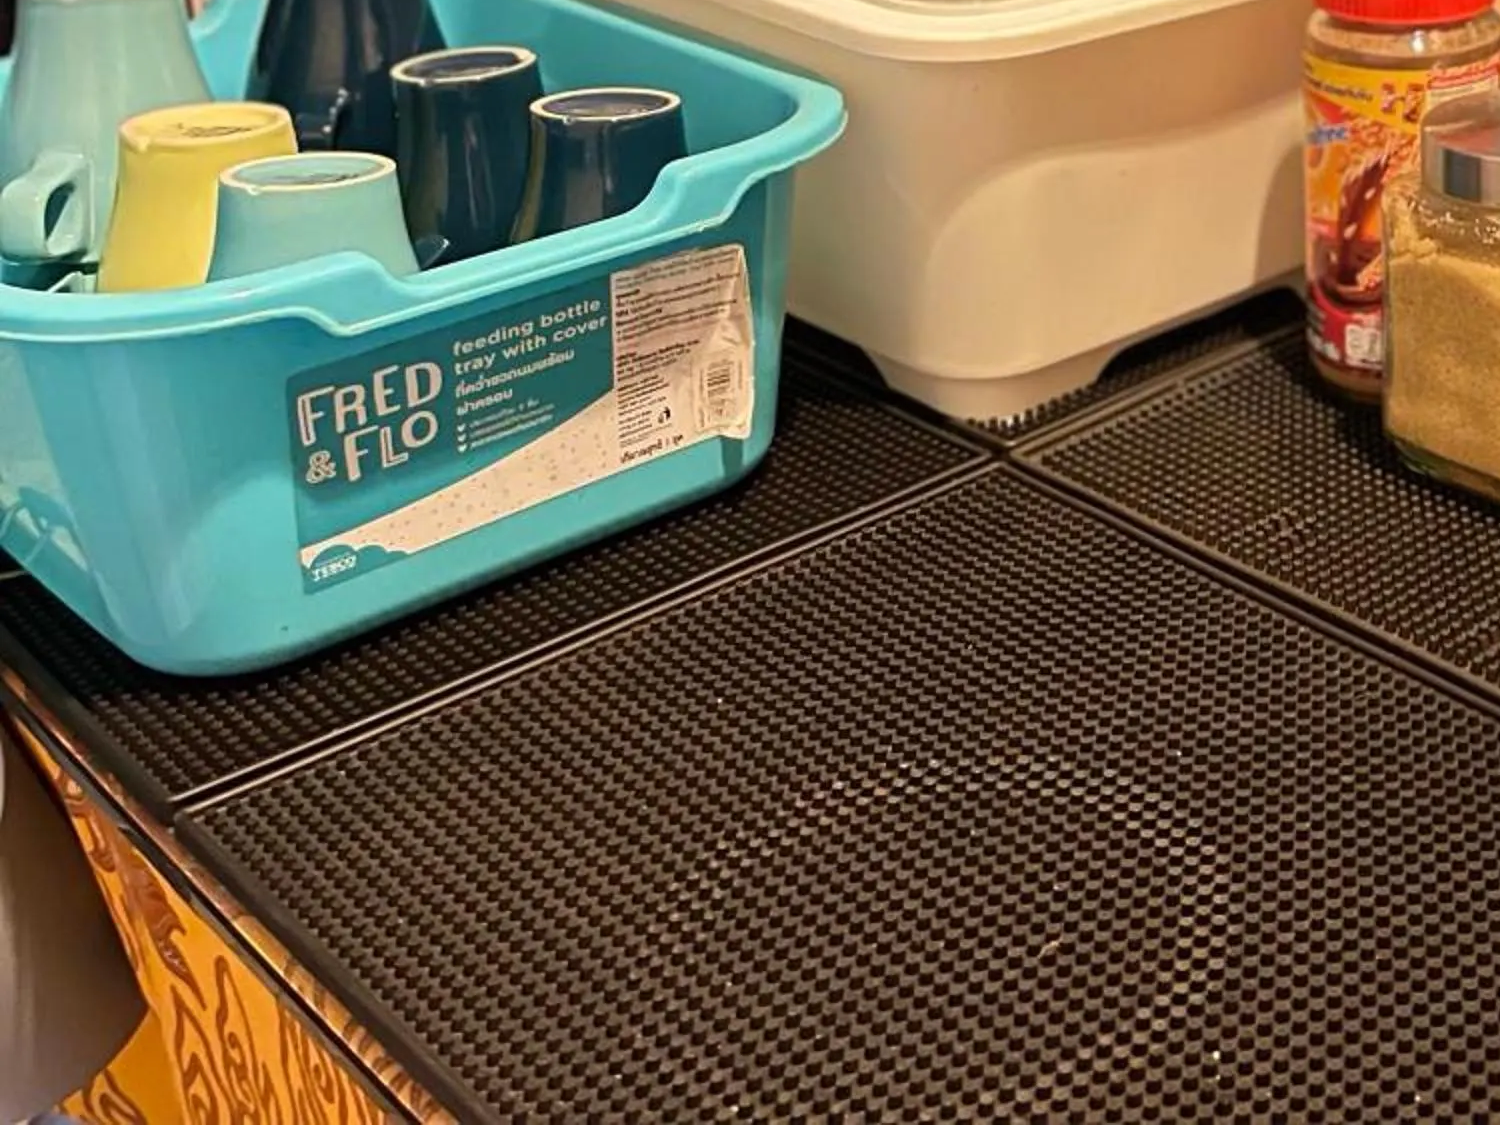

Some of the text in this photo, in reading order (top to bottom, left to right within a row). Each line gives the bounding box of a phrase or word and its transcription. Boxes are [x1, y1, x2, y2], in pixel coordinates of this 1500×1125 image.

[453, 321, 534, 356] feeding
[540, 299, 601, 328] bottle
[454, 315, 608, 376] tray with cover
[297, 361, 443, 446] FRED
[305, 450, 337, 484] &
[344, 410, 438, 482] FLO
